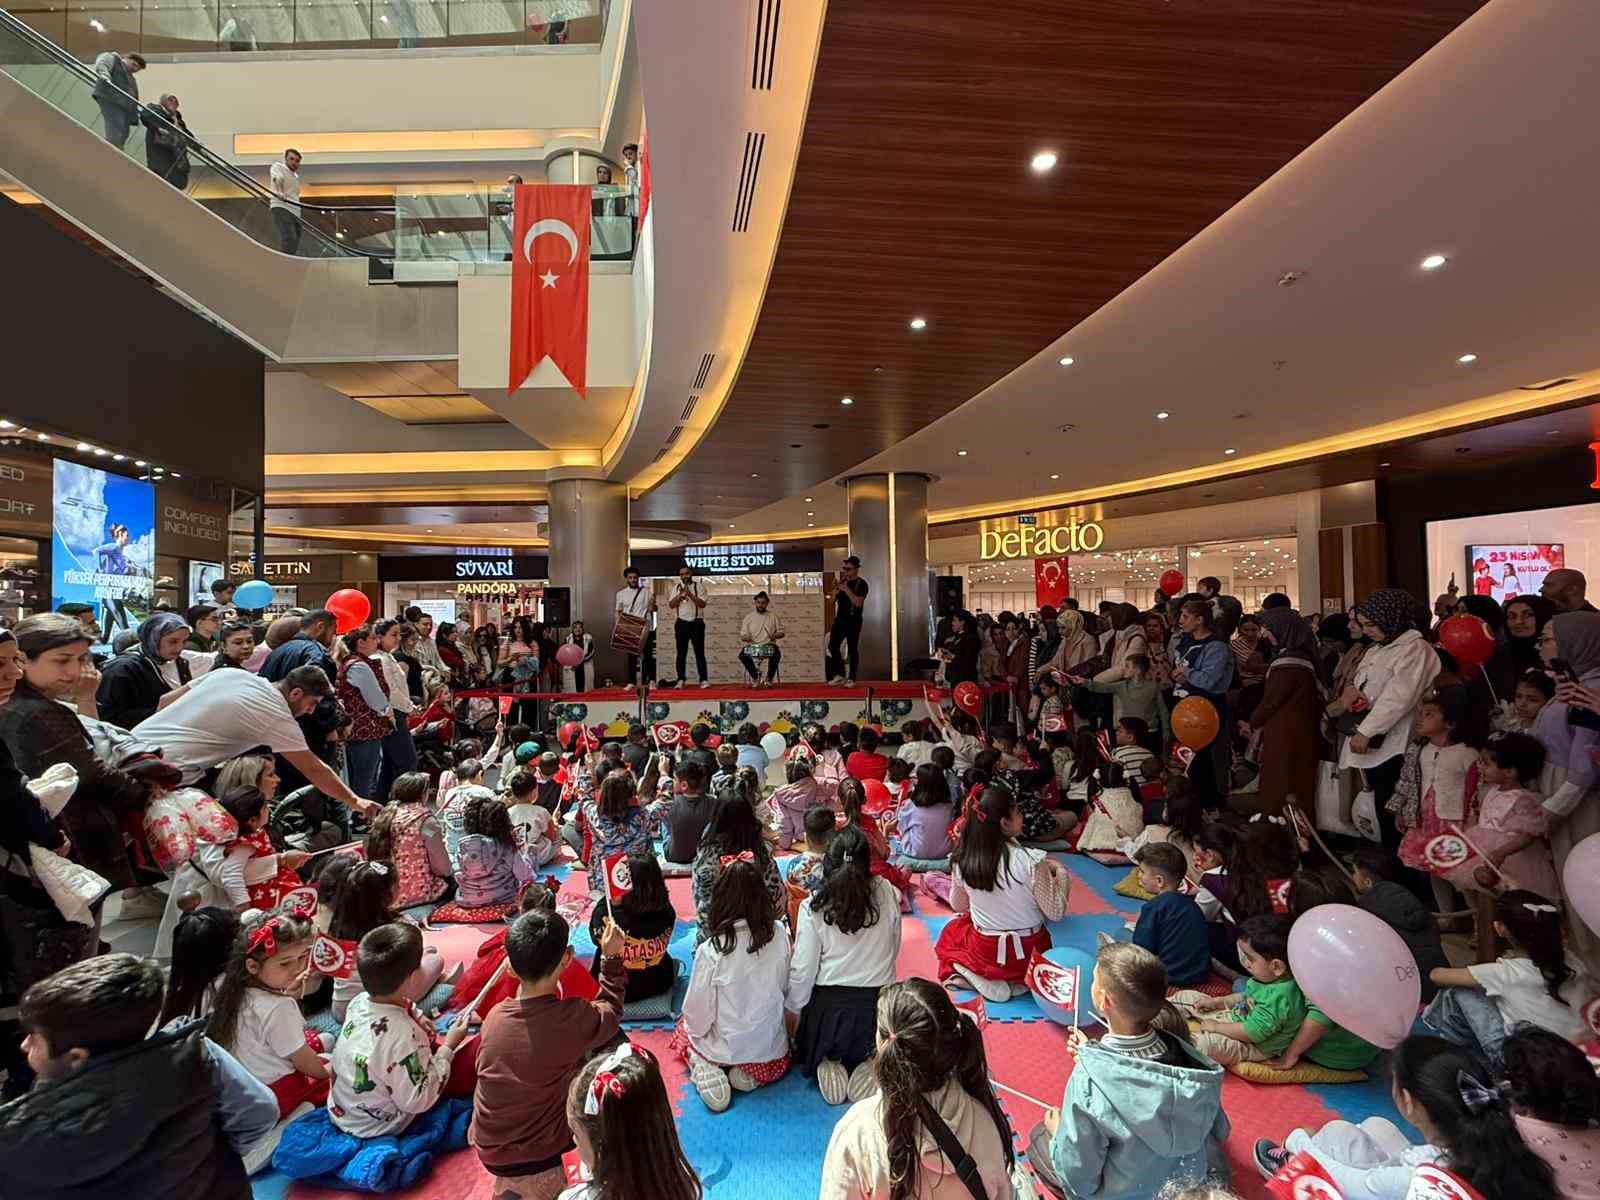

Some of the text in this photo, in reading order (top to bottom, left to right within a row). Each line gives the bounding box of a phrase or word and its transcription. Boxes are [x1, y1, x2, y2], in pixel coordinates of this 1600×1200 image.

[164, 506, 222, 528] COMFORT
[164, 520, 221, 541] INCLUDED
[981, 516, 1104, 560] DeFacto
[685, 554, 774, 568] WHITE STONE
[1489, 551, 1508, 562] 23
[457, 583, 517, 594] PANDORA
